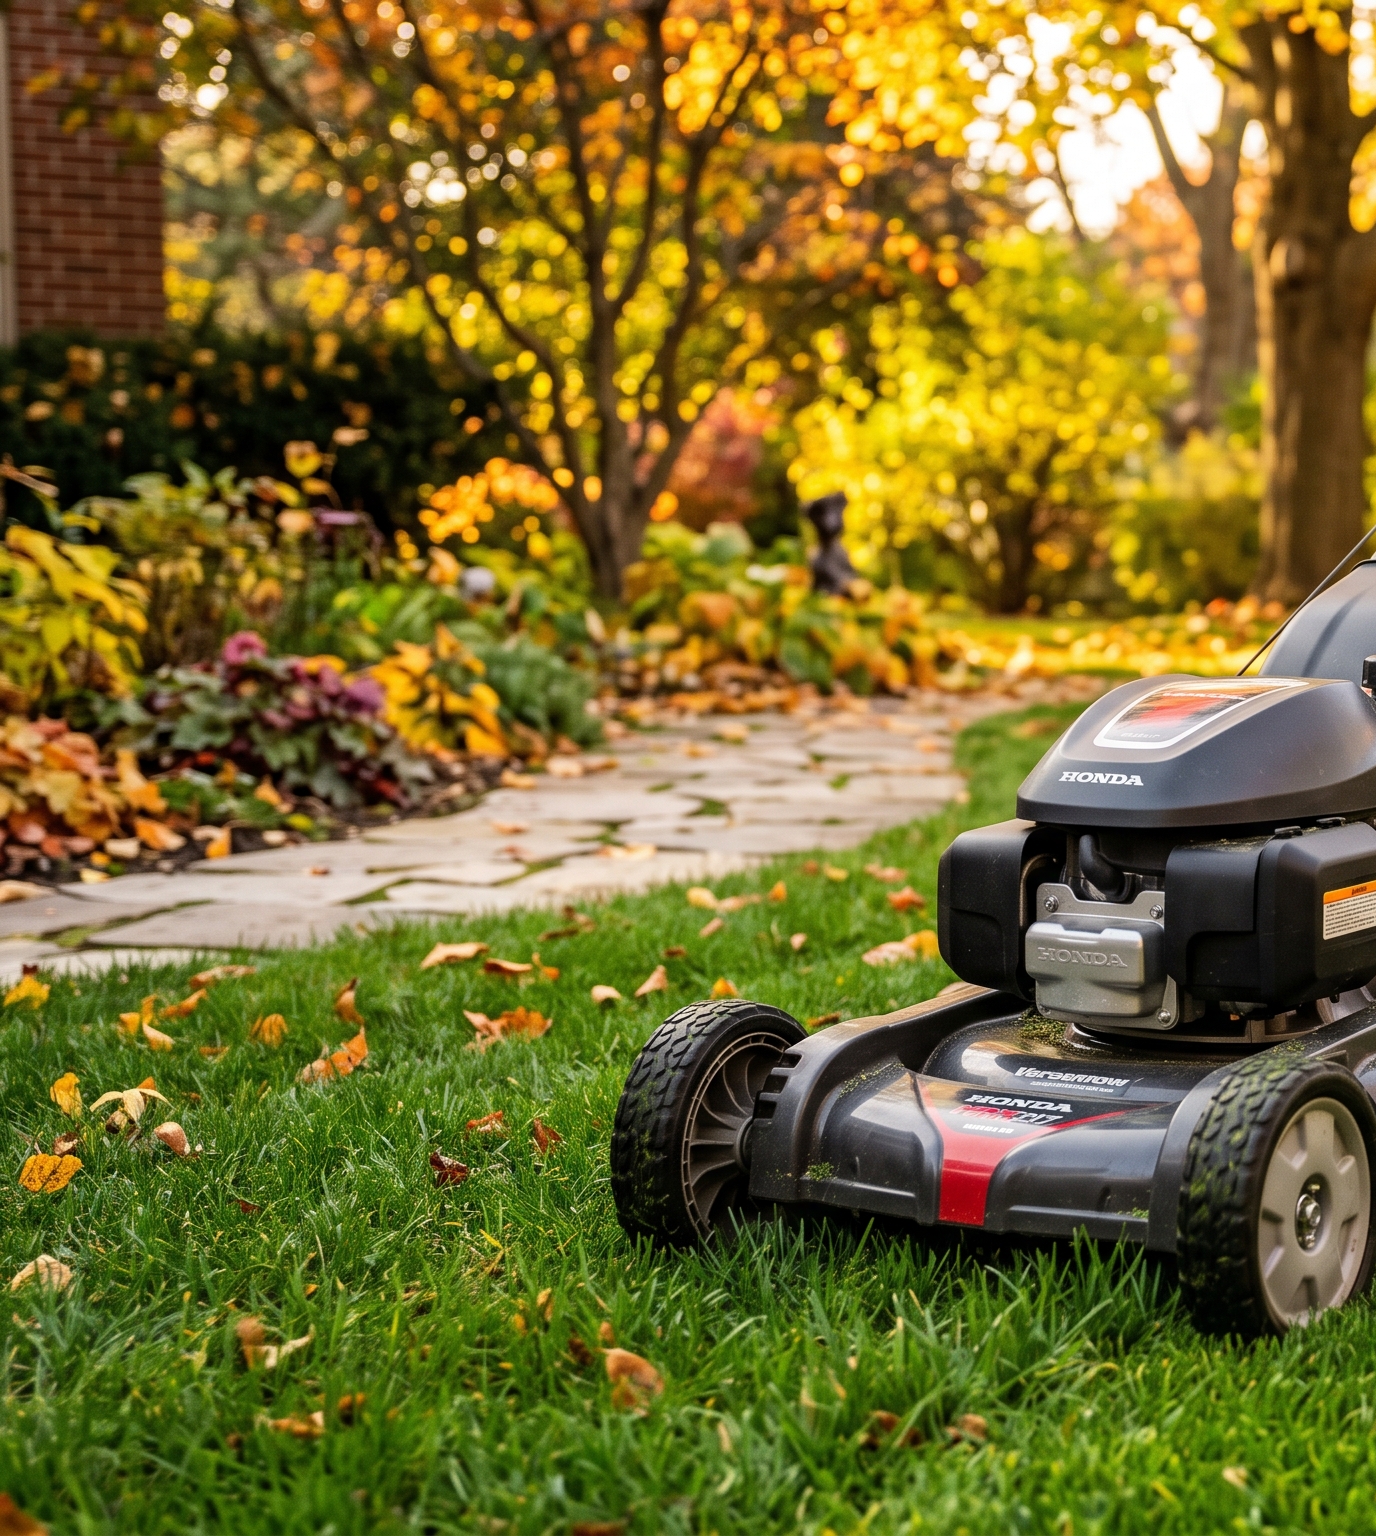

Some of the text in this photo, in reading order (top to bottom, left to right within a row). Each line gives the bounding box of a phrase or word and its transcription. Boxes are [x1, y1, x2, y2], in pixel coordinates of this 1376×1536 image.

[1058, 771, 1144, 786] HONDA
[1037, 946, 1128, 968] HONDA
[964, 1094, 1073, 1113] HONDA
